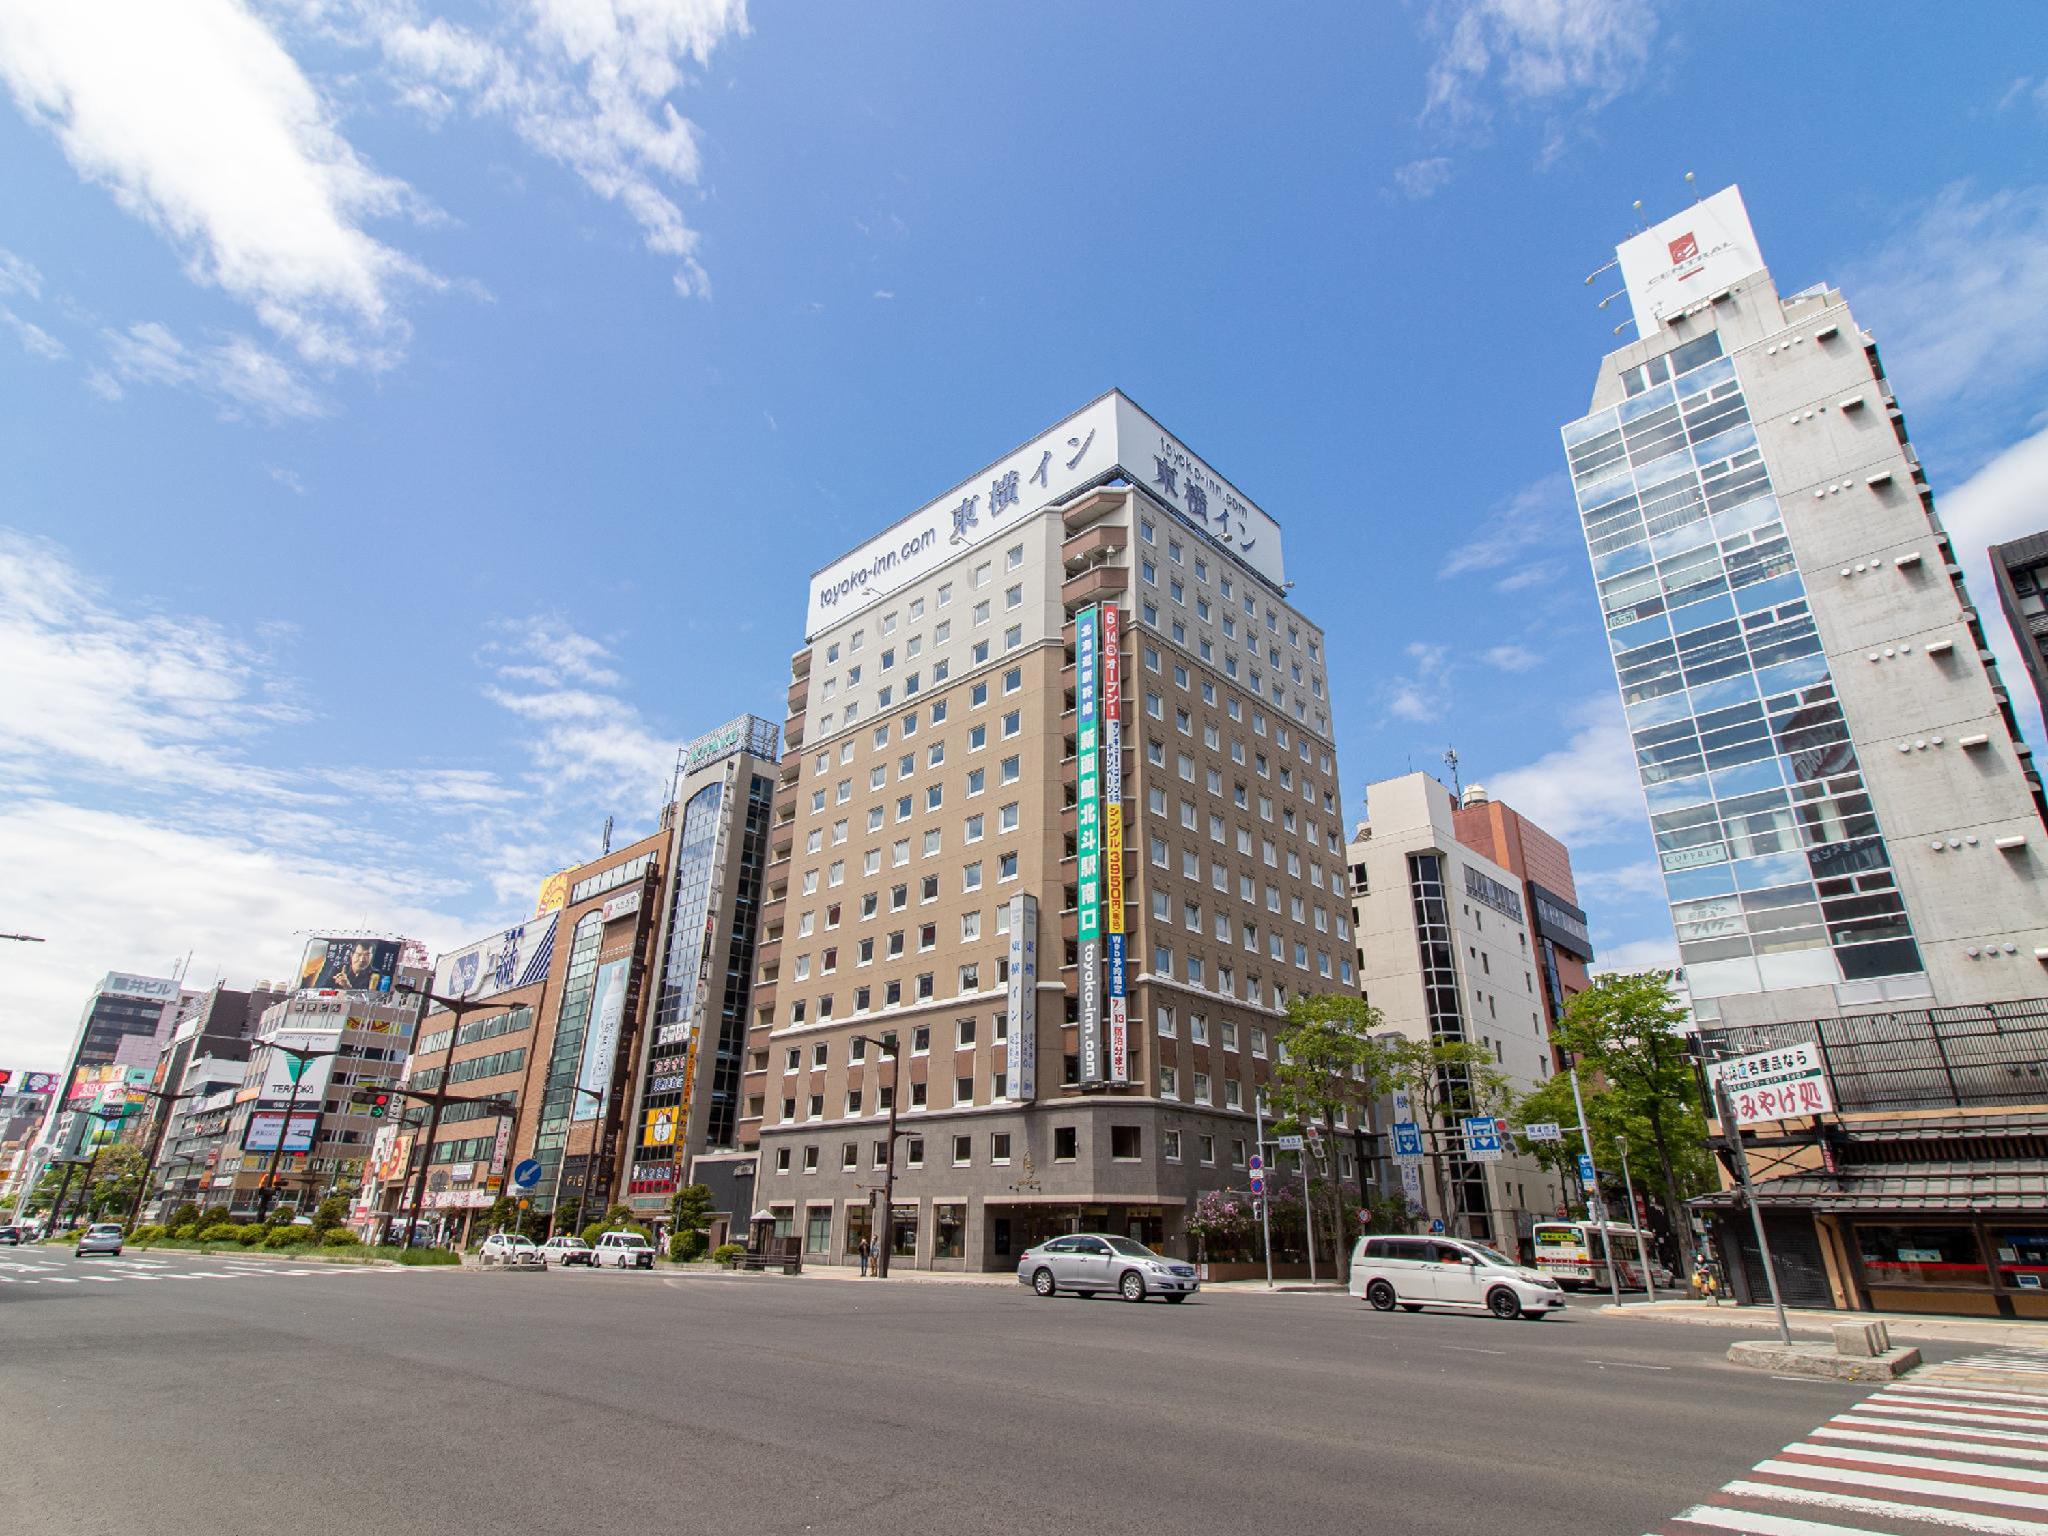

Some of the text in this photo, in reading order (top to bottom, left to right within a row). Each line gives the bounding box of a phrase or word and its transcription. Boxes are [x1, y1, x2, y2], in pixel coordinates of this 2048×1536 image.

[950, 427, 1096, 537] 東横イン
[1152, 453, 1257, 553] 東横イン
[1159, 434, 1250, 520] toyoko-inn.com
[819, 524, 937, 609] toyoko-inn.com
[1083, 943, 1096, 1078] toyoko-inn.com
